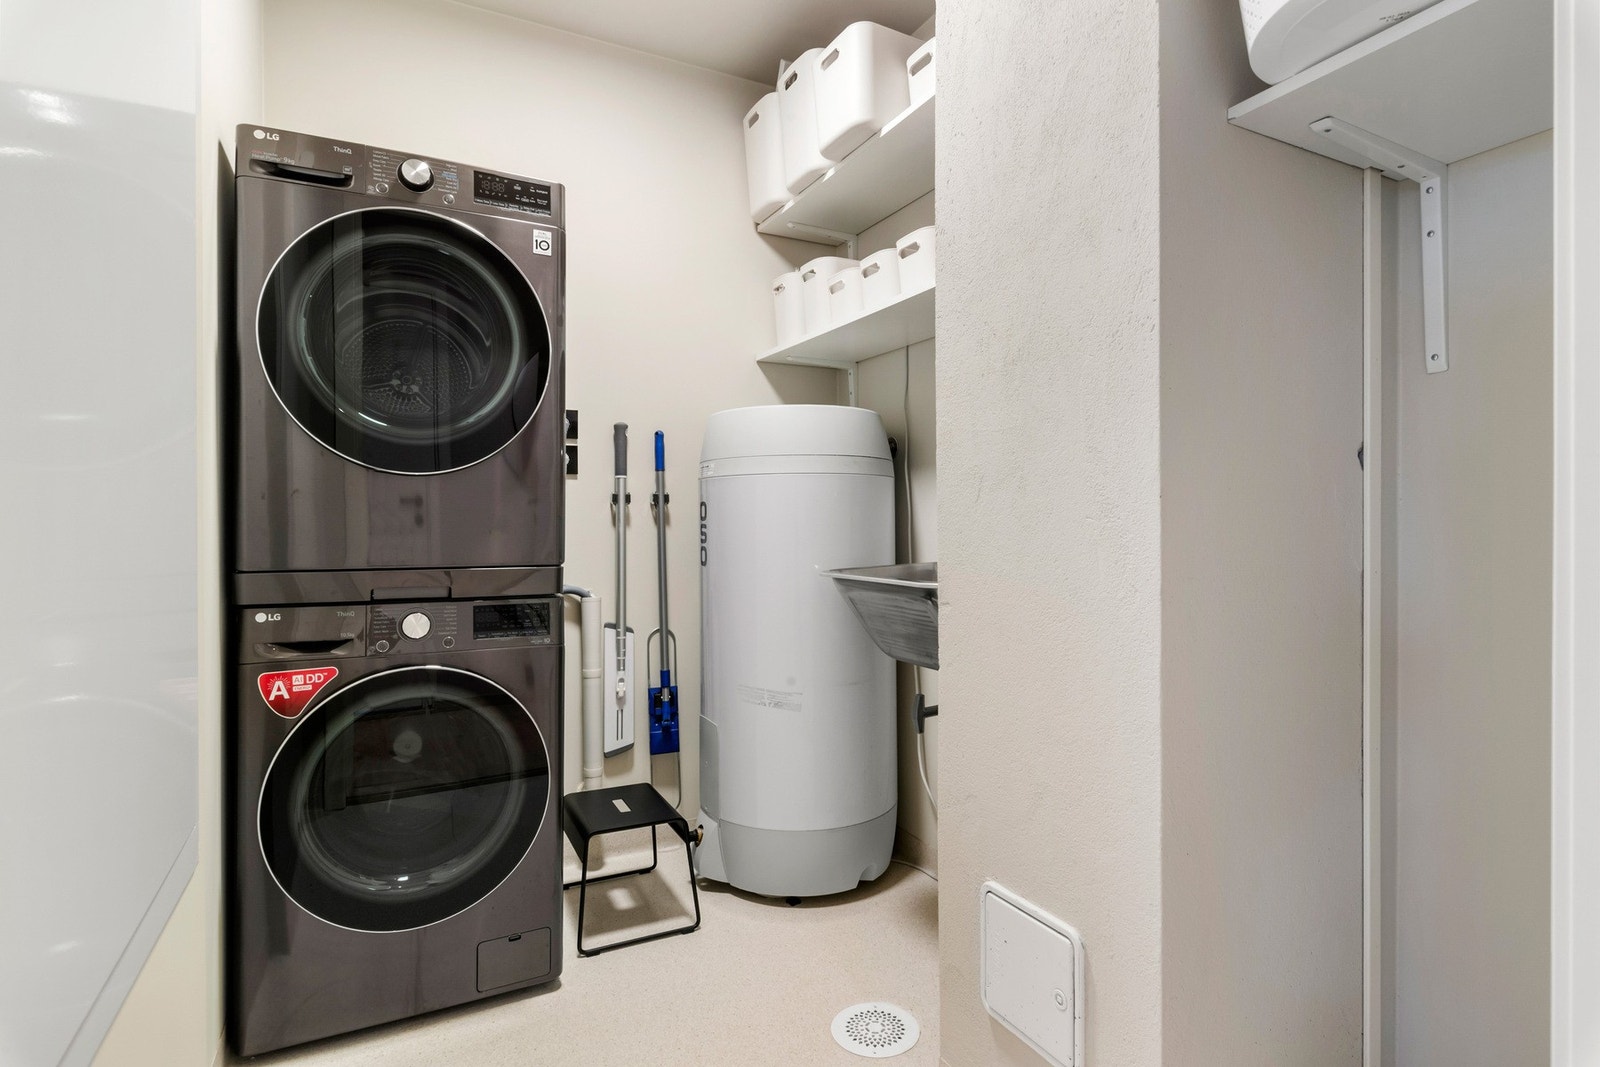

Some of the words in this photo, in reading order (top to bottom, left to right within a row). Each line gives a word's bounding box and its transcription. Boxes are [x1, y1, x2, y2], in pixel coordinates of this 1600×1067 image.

[267, 133, 280, 141] LG
[333, 146, 352, 155] ThinQ
[535, 239, 550, 251] 10
[268, 613, 281, 621] LG
[268, 680, 290, 701] A
